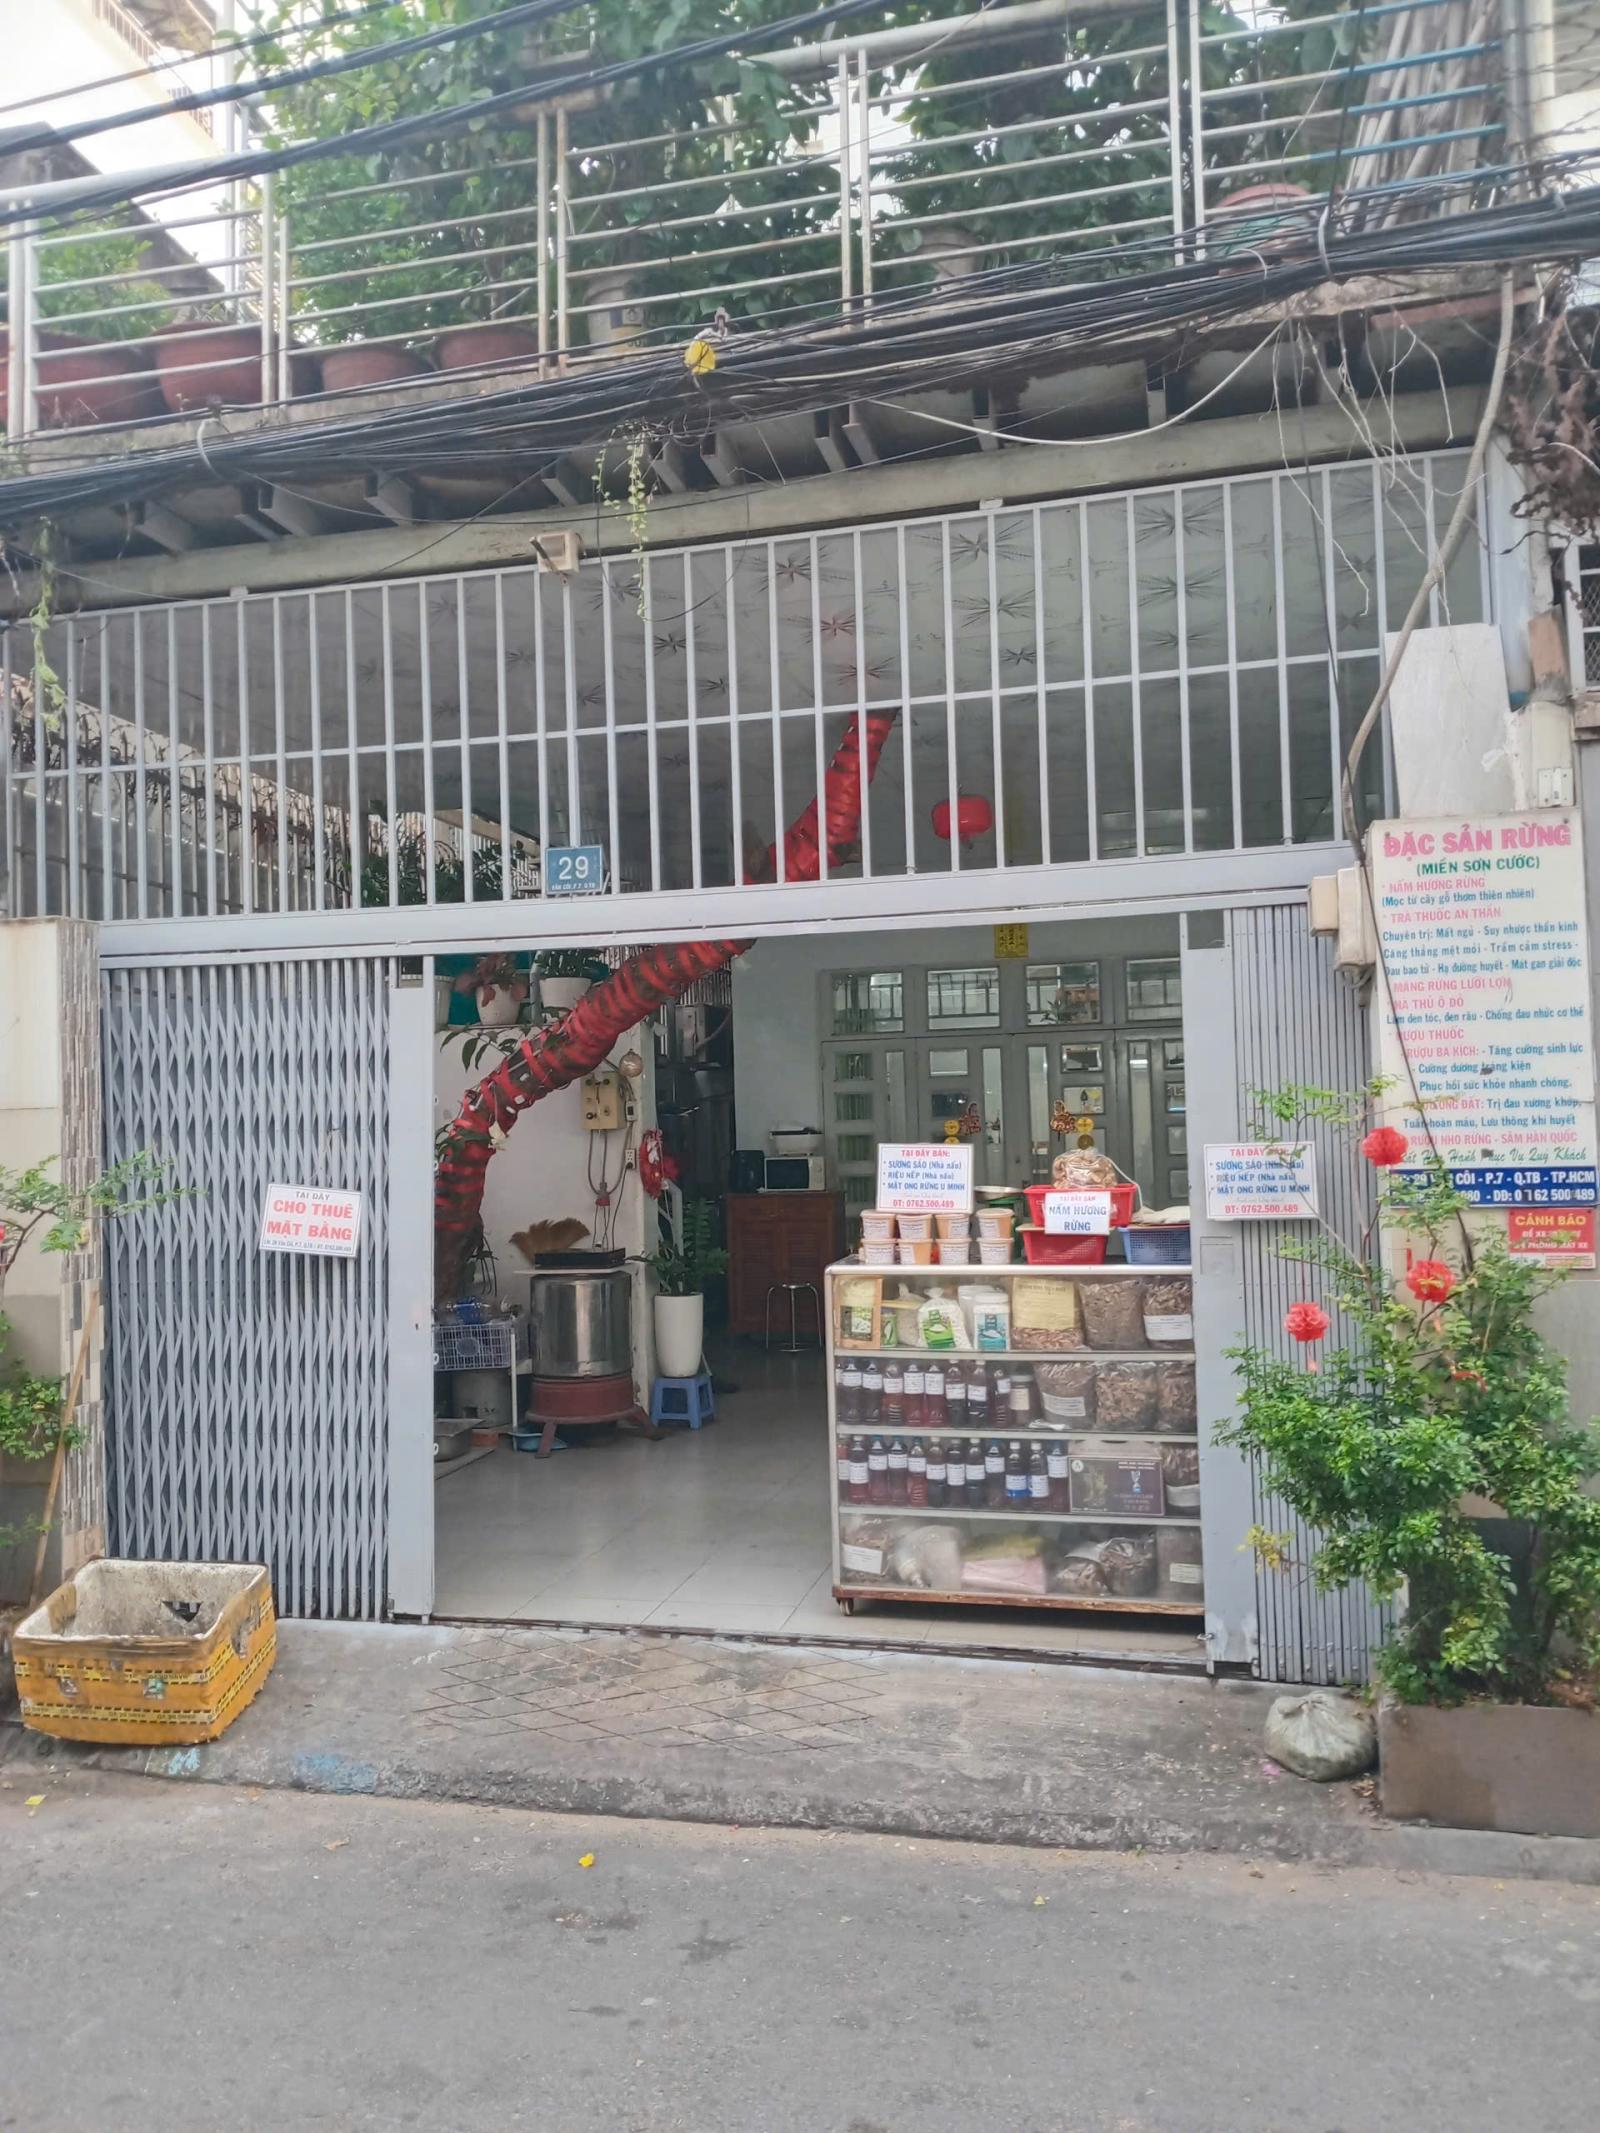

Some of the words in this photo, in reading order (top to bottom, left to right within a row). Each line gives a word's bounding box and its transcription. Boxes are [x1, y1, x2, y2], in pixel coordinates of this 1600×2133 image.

[1384, 831, 1435, 861] ĐẶC
[1442, 823, 1492, 853] SẢN
[1501, 822, 1571, 849] RỪNG
[559, 856, 588, 880] 29
[1455, 1170, 1475, 1185] CÔI
[1485, 1172, 1504, 1185] P.7
[1514, 1172, 1540, 1186] Q.TB
[1550, 1170, 1595, 1184] TP.HCM
[1551, 1188, 1571, 1201] 500
[1574, 1188, 1595, 1201] 489
[273, 1200, 306, 1214] CHO
[312, 1203, 353, 1218] THUÊ
[1064, 1219, 1091, 1231] RỪNG
[1515, 1213, 1554, 1226] CẢNH
[1557, 1213, 1586, 1226] BÁO
[267, 1220, 302, 1238] MẶT
[308, 1221, 352, 1241] BẰNG
